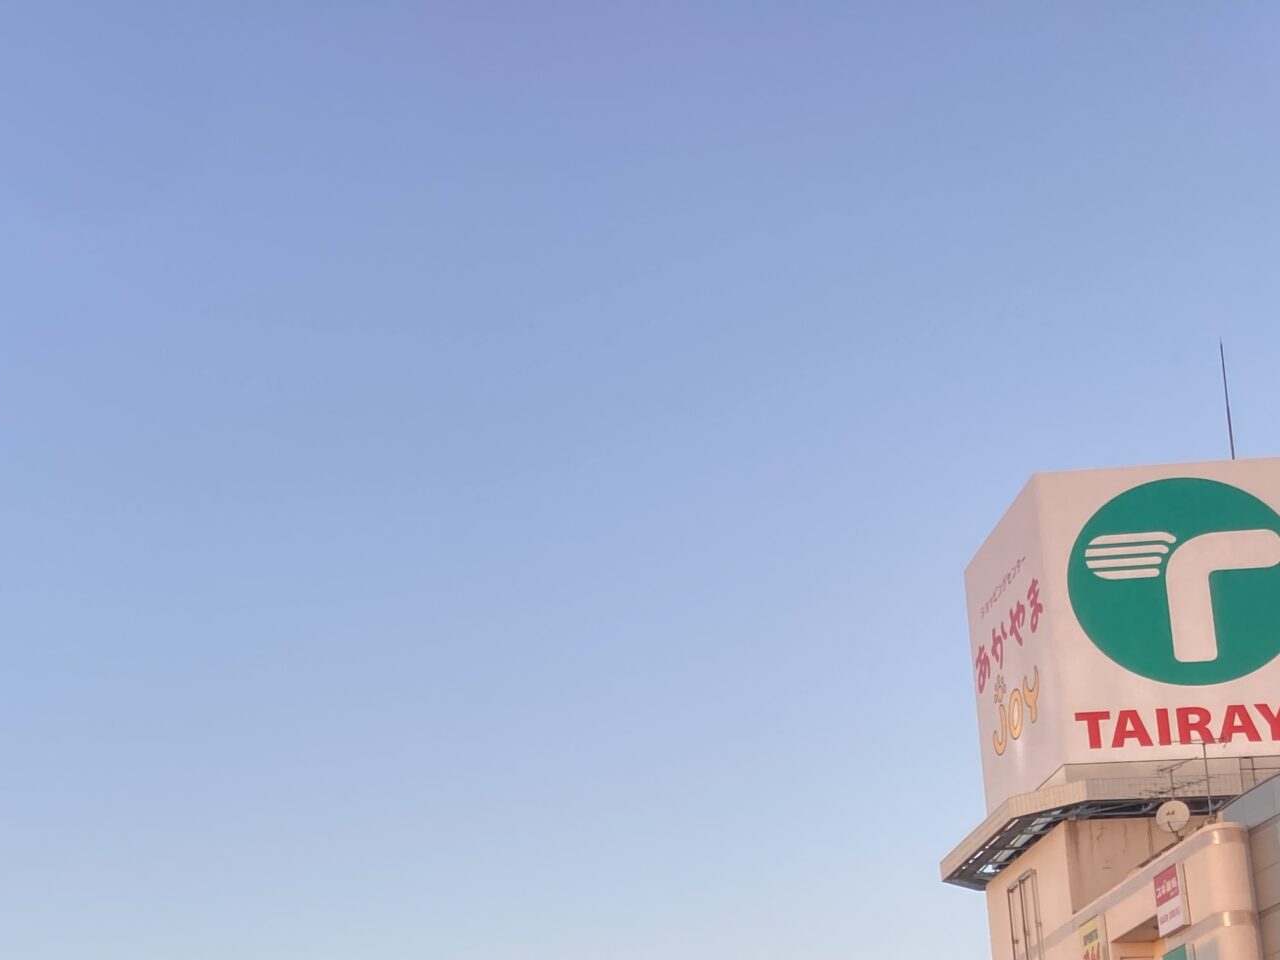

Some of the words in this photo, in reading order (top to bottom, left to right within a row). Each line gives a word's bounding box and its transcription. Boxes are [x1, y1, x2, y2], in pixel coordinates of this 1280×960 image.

[976, 578, 1043, 694] あかやま
[1074, 703, 1280, 749] TAIRAY
